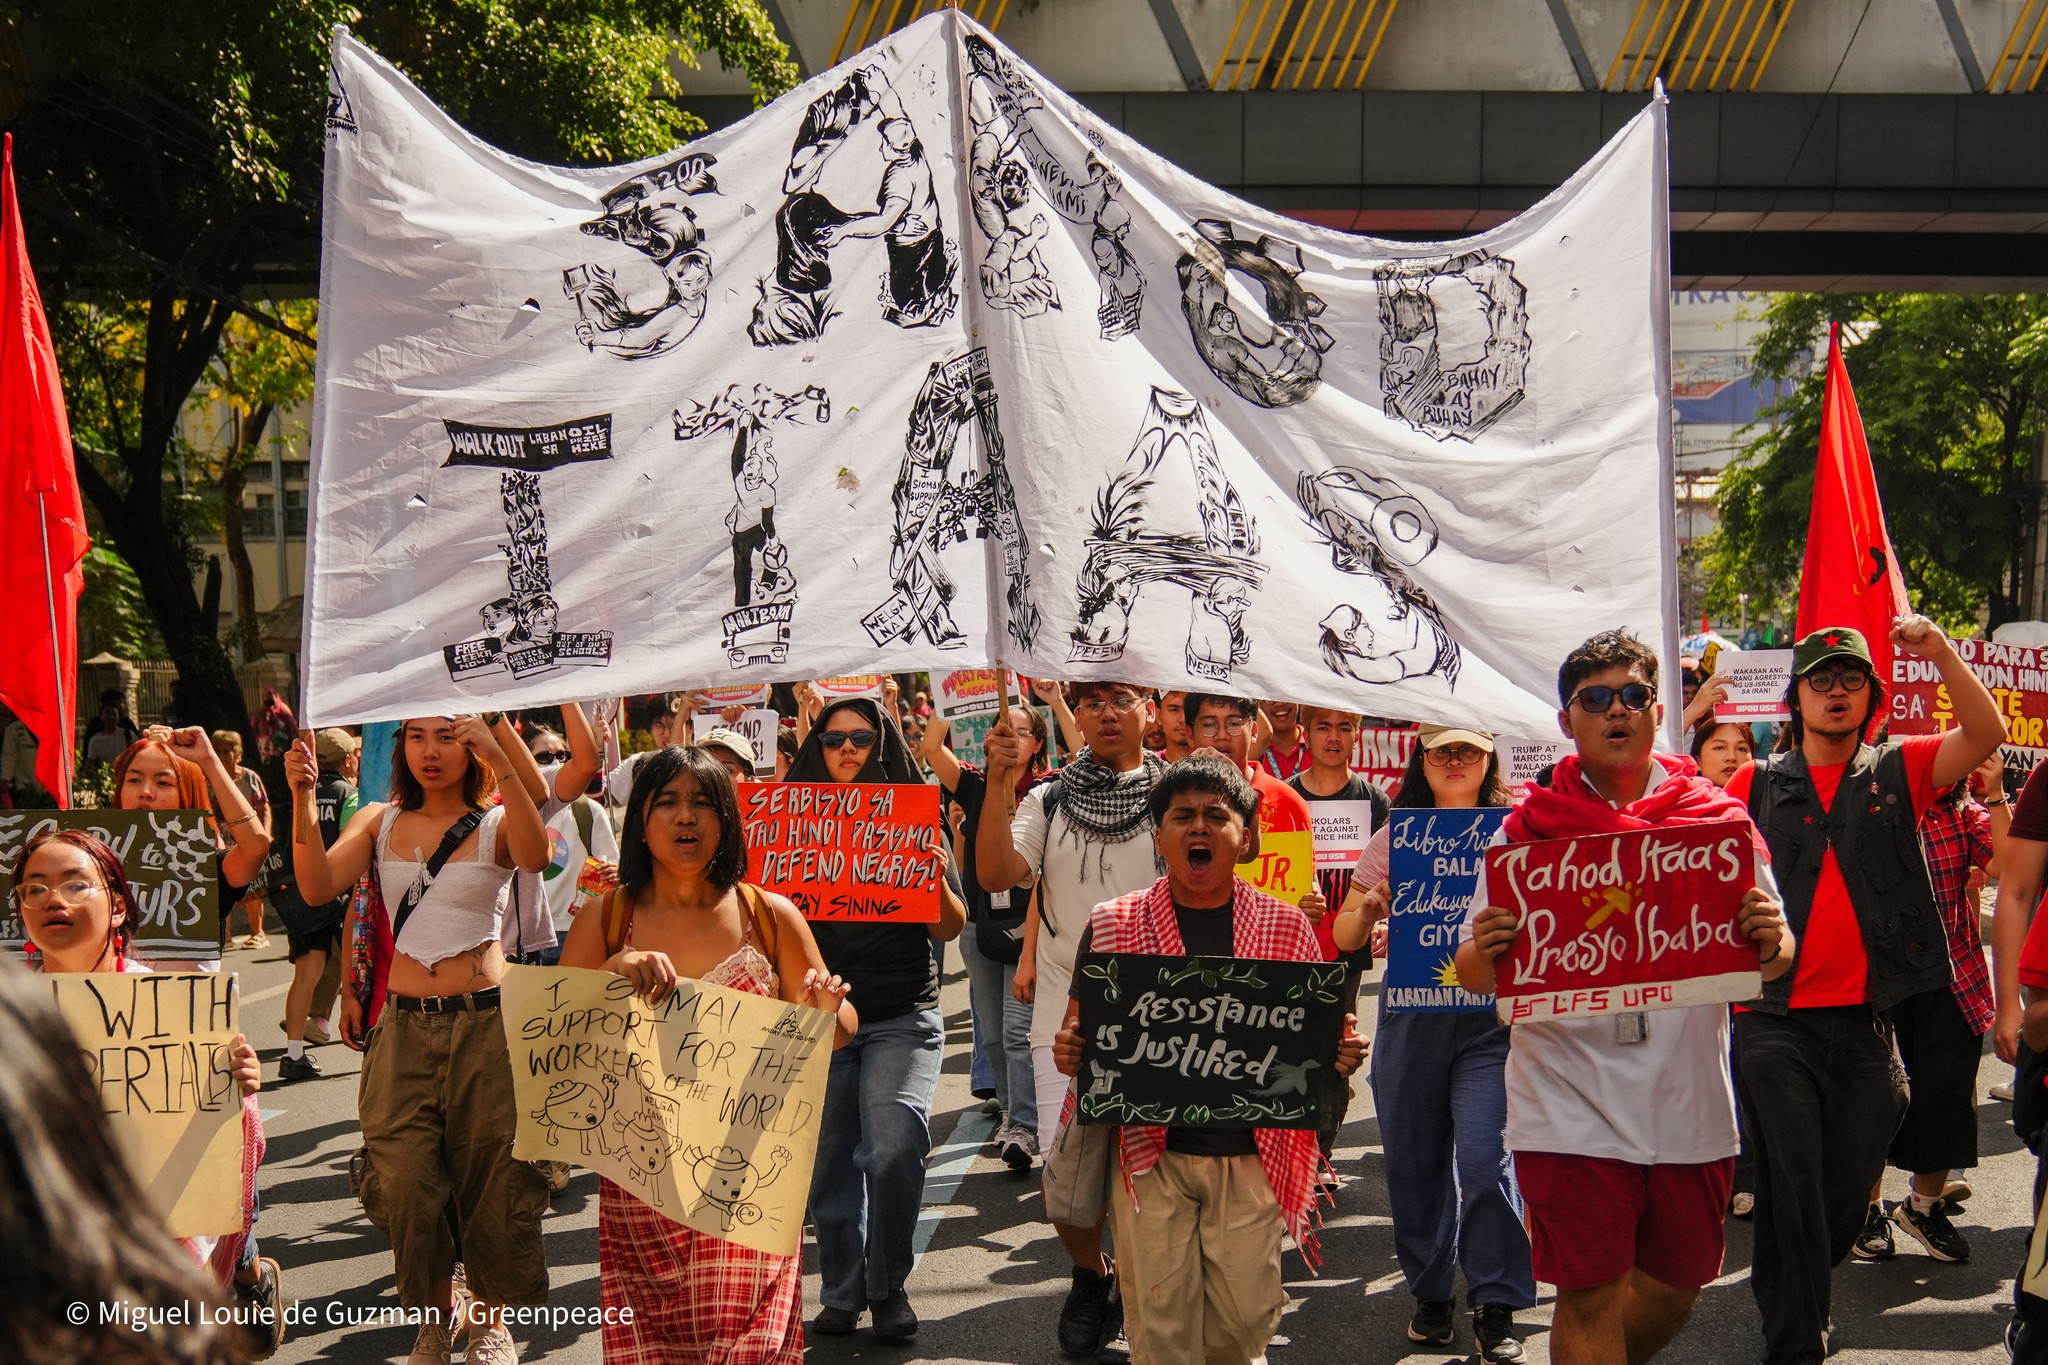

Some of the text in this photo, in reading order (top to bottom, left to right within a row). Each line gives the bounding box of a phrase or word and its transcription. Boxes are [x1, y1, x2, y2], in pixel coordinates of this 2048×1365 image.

[1447, 363, 1500, 392] BAHAY
[528, 428, 568, 445] LABAN
[568, 424, 608, 438] OIL
[450, 432, 527, 459] WALK OUT
[542, 444, 560, 455] SA
[865, 598, 908, 630] WELGA
[455, 640, 487, 656] FREE
[508, 649, 545, 664] JUSTICE
[558, 646, 609, 657] SCHOOLS
[1984, 642, 2035, 668] PARA
[459, 659, 487, 670] NOW
[1188, 658, 1230, 678] NEGROS
[984, 700, 999, 709] US
[1936, 684, 2024, 717] STE
[1513, 754, 1552, 762] MARCOS
[746, 785, 895, 819] SERBISYO SA
[745, 818, 936, 852] TAO HINDI PASISMO
[1393, 815, 1461, 855] Libro
[760, 848, 845, 886] DEFEND
[1253, 852, 1295, 892] JR.
[827, 894, 903, 917] SINING
[1391, 879, 1474, 922] Edukasyo
[85, 975, 234, 1040] WITH
[544, 977, 570, 1012] I
[1388, 988, 1453, 1007] KABATAAN
[521, 1008, 811, 1084] SUPPORT FOR THE
[529, 1042, 813, 1137] WORKERS OF THE WORLD
